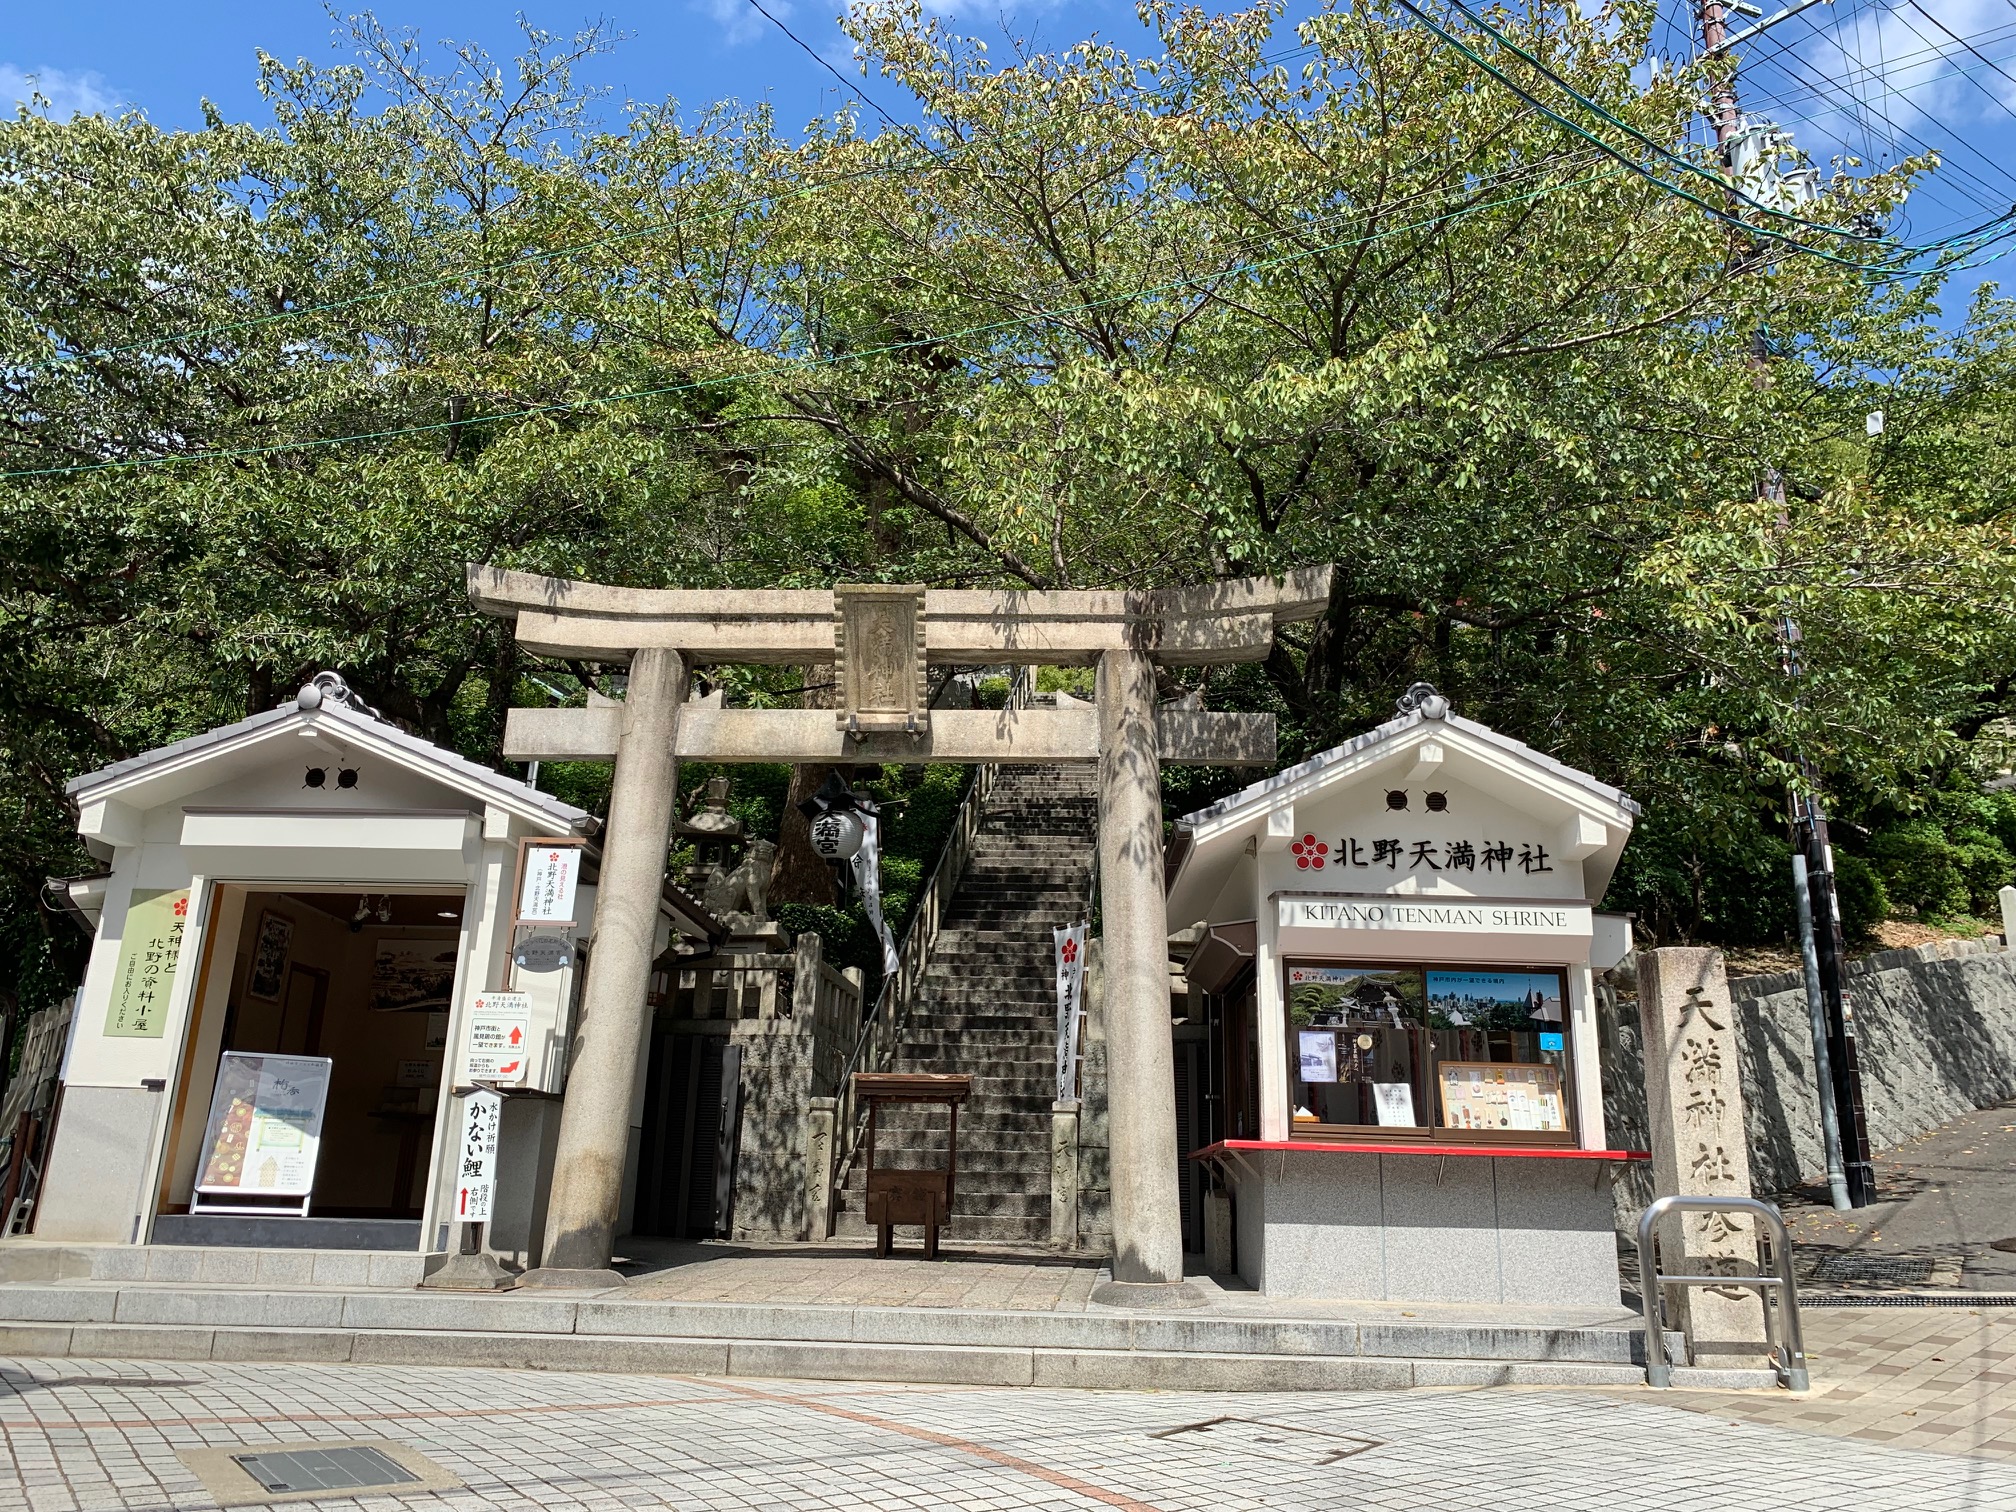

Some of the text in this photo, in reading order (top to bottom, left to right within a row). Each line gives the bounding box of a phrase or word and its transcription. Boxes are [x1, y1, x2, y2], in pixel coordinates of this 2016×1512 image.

[866, 608, 897, 708] 天満神社
[815, 810, 842, 854] 天満宮
[1333, 837, 1553, 874] 北野天満神社
[542, 862, 558, 915] 北野天満神社
[557, 863, 568, 900] 港の見える社
[1305, 904, 1567, 927] KITANO TENMAN SHRINE
[164, 921, 185, 974] 天神様と
[117, 953, 138, 1029] ご自由にお入りください
[131, 938, 165, 1031] 北野の資料小屋
[485, 1001, 529, 1009] 北野天満神社
[462, 1102, 487, 1178] かない鯉
[485, 1102, 498, 1154] 水かけ祈願
[469, 1187, 478, 1218] 右側です
[479, 1184, 490, 1216] 階段の上
